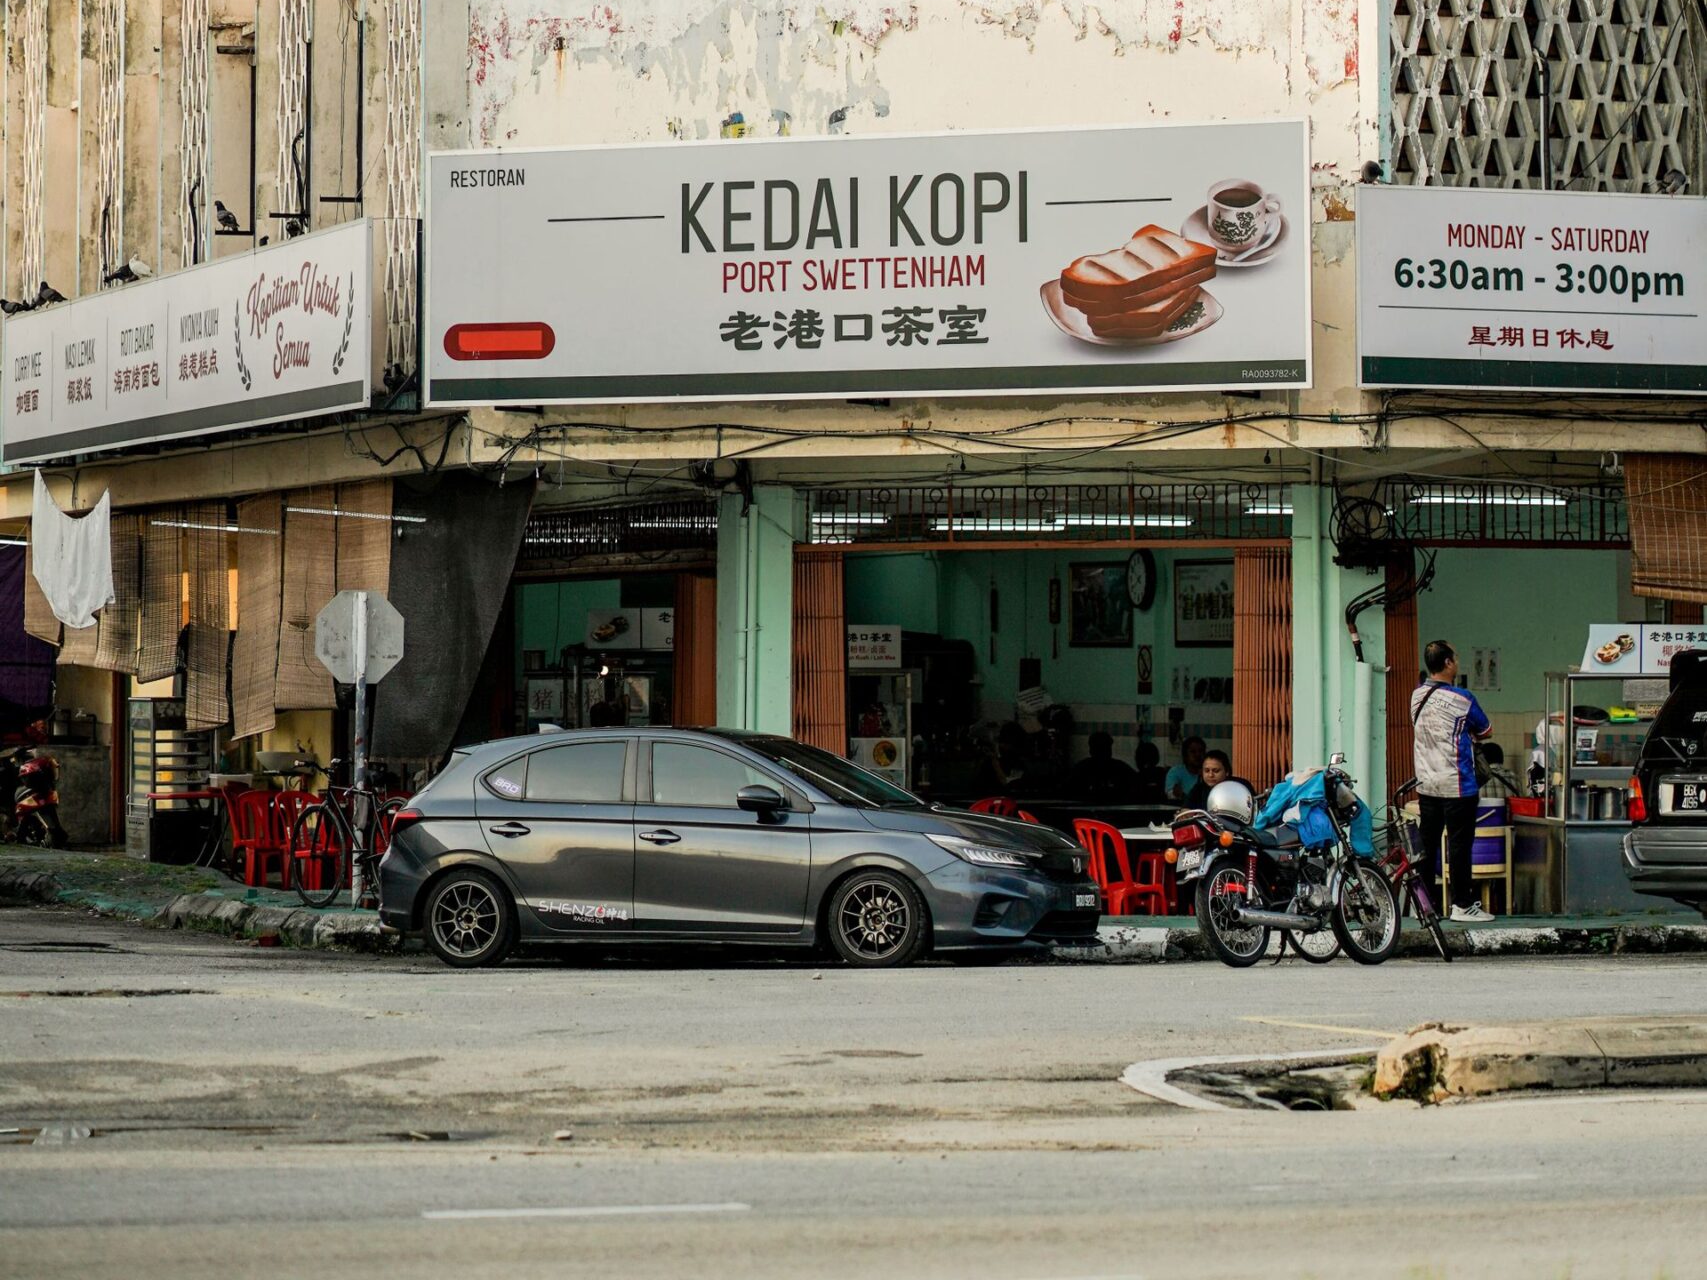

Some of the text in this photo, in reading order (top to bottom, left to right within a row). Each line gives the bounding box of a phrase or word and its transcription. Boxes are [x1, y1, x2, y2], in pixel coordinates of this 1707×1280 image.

[450, 168, 525, 189] RESTORAN
[681, 171, 1028, 255] KEDAI KOPI
[1447, 223, 1526, 250] MONDAY
[1550, 226, 1650, 254] SATURDAY
[722, 254, 986, 294] PORT SWETTENHAM
[1394, 257, 1524, 292] 6:30am
[1554, 262, 1685, 304] 3:00pm
[247, 261, 341, 339] Kopitiam Untuk
[121, 323, 155, 357] ROTI BAKAR
[180, 308, 219, 343] NYONYA KUIH
[718, 304, 990, 352] 老港口茶室
[1467, 325, 1614, 351] 星期日休息
[15, 351, 42, 382] CURRY MEE
[65, 338, 96, 370] NASI LEMAK
[179, 348, 219, 381] 娘惹糕点
[272, 322, 311, 380] Semua
[67, 376, 93, 405] 椰浆饭
[114, 361, 161, 395] 海南烤面包
[1241, 369, 1300, 383] RA0093782-K
[573, 915, 595, 924] RACING
